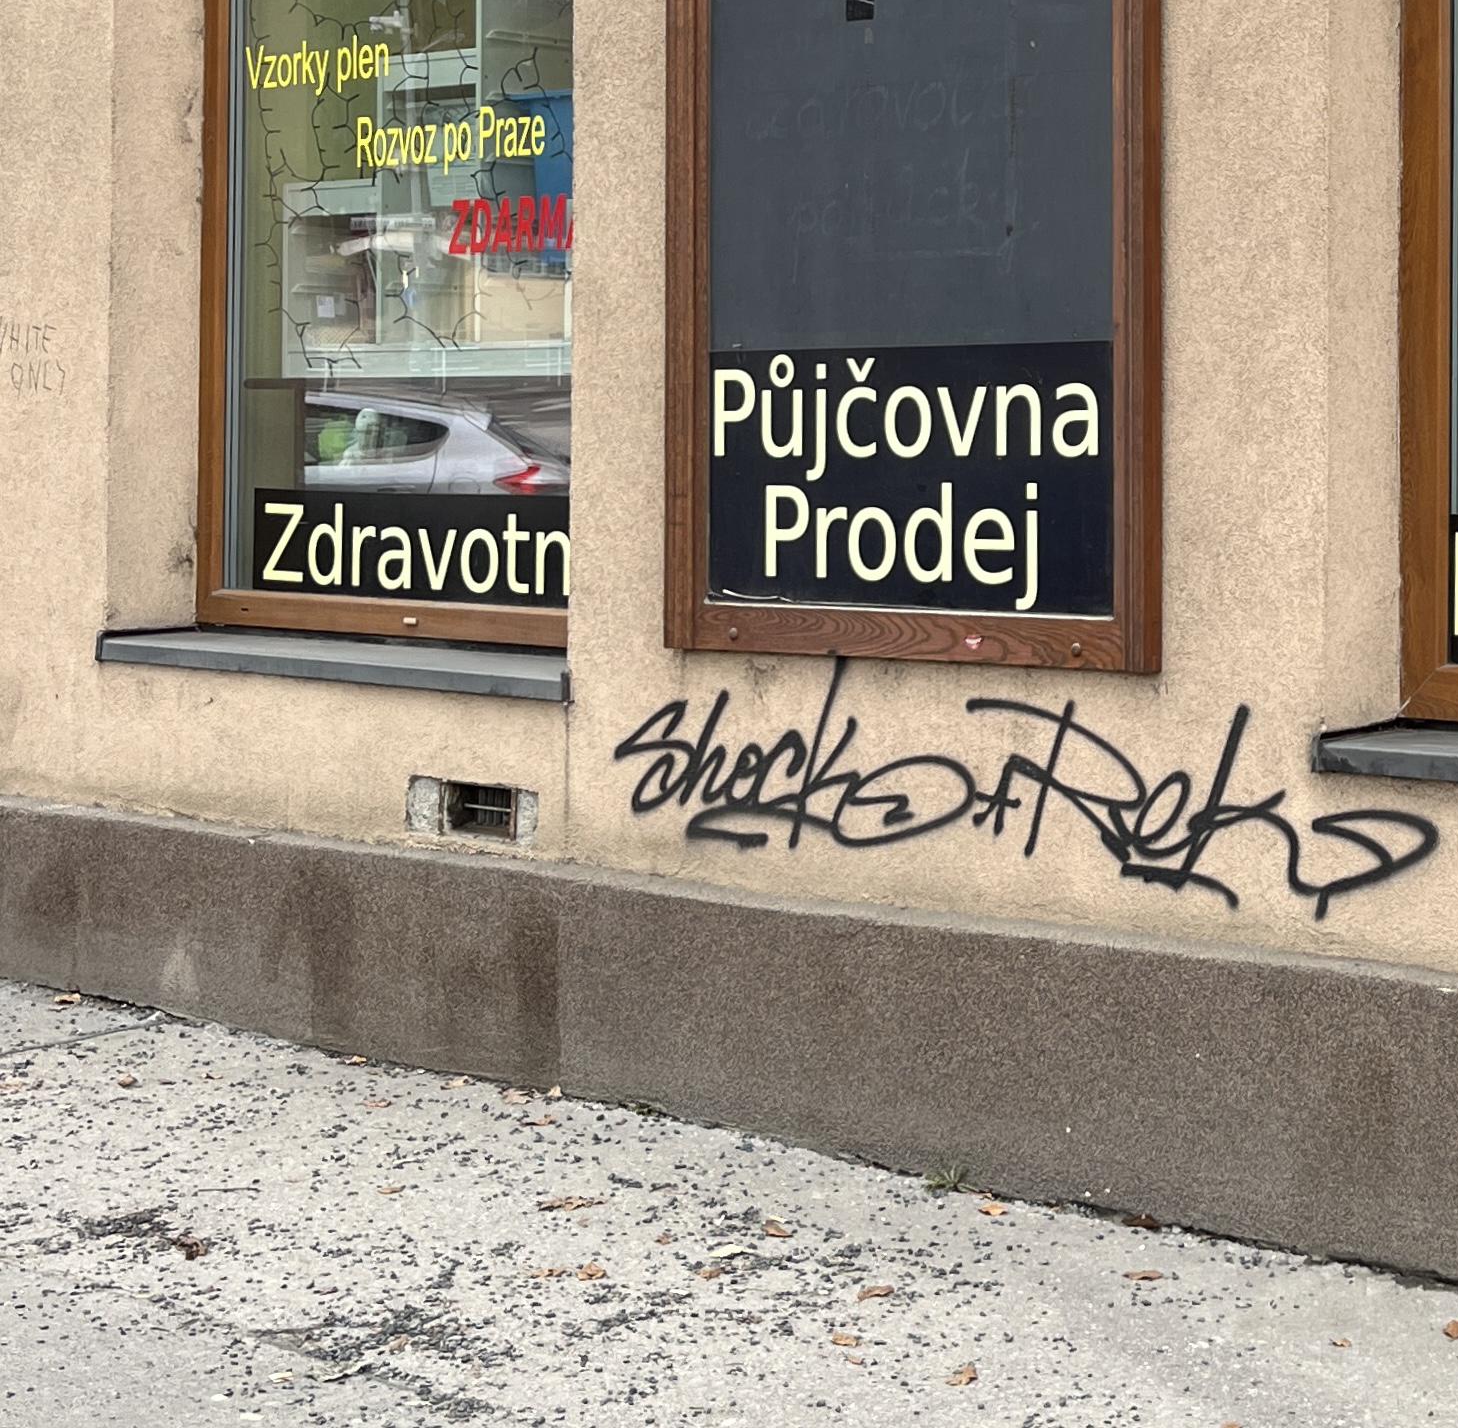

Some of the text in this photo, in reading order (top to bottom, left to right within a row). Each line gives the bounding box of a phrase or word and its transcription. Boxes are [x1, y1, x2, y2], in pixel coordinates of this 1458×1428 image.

[246, 34, 390, 97] Vzorky plen
[356, 105, 546, 175] Rozvoz po Praze
[713, 354, 1101, 481] Půjčovna
[262, 501, 571, 597] Zdravotn
[764, 482, 1040, 611] Prodej
